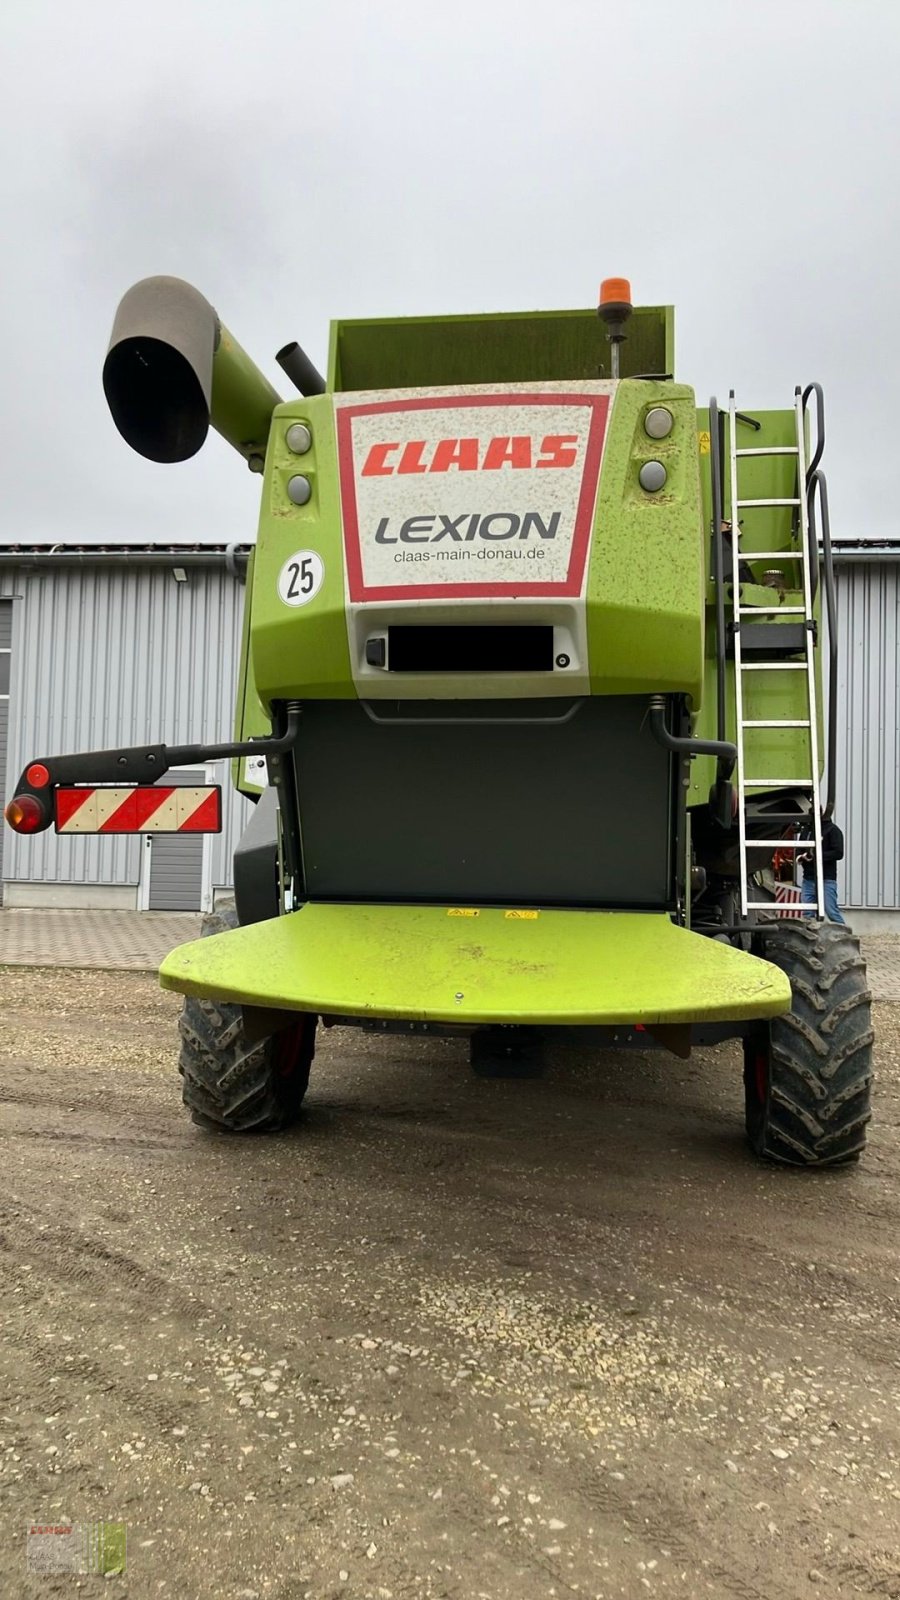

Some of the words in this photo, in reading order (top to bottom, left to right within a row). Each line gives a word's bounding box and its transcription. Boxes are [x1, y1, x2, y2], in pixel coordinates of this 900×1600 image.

[361, 436, 578, 476] CLAAS
[375, 512, 562, 544] LEXION
[394, 547, 545, 563] claas-main-donau.de
[287, 558, 314, 599] 25
